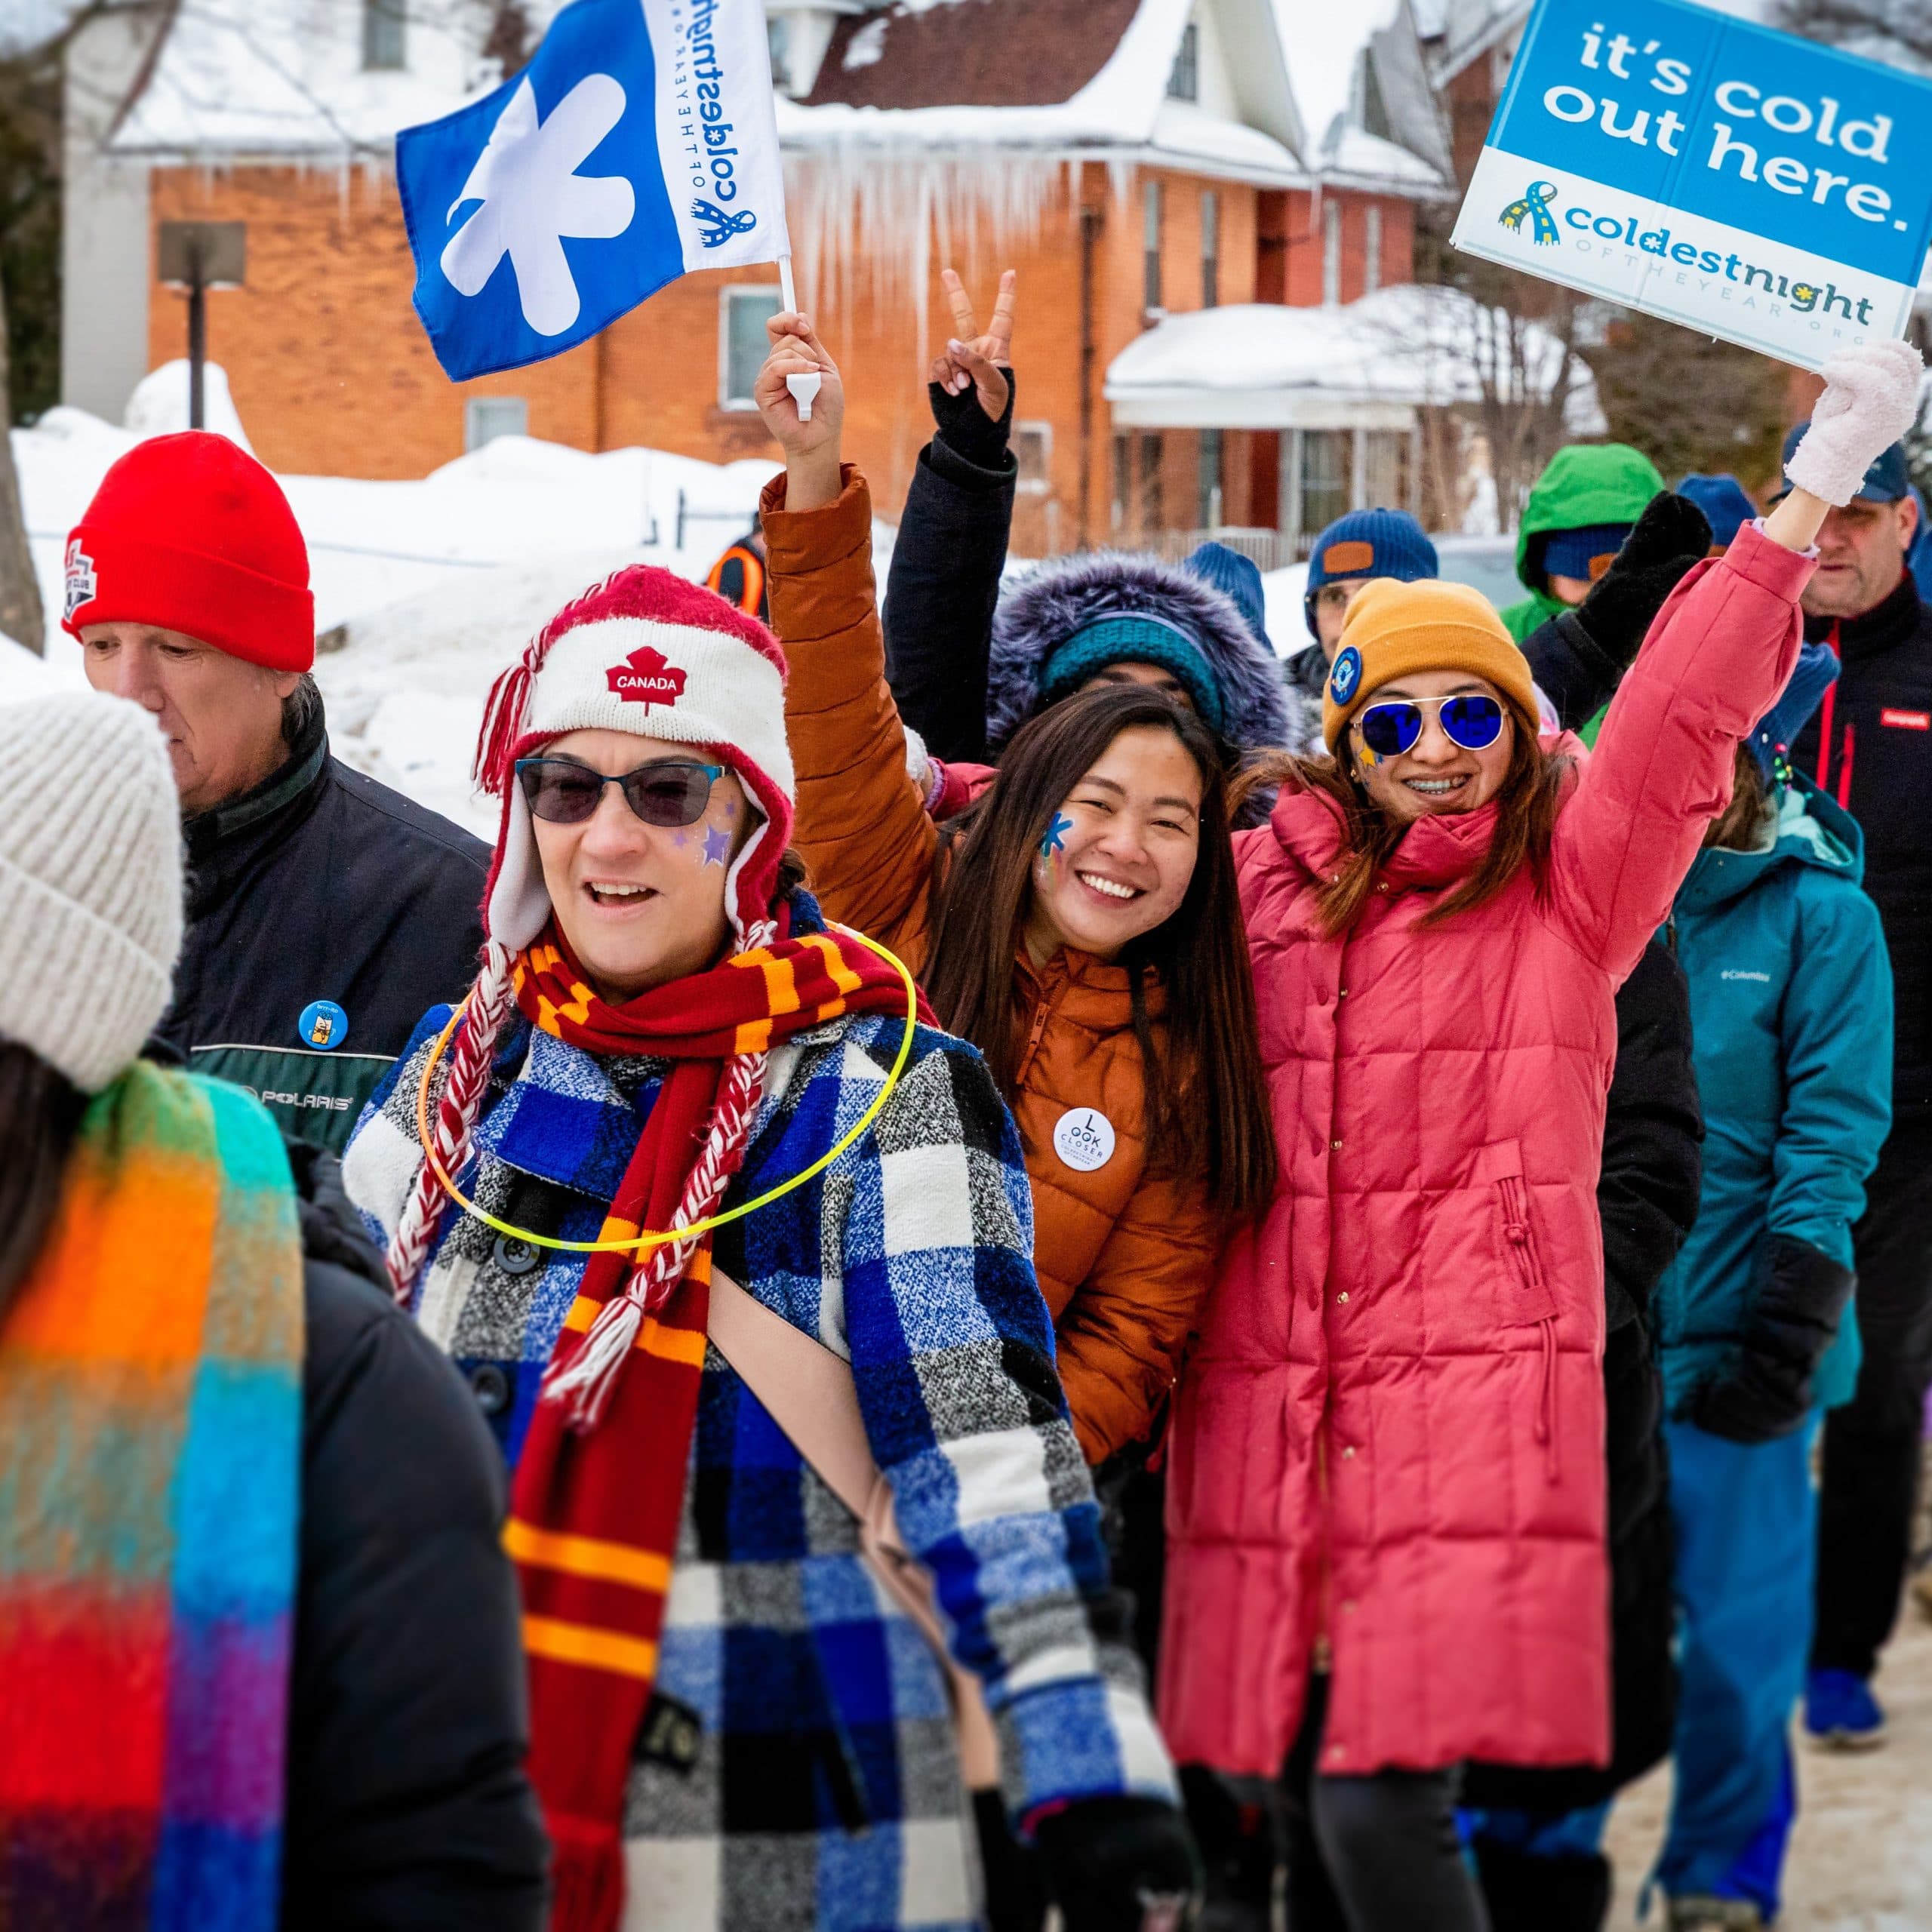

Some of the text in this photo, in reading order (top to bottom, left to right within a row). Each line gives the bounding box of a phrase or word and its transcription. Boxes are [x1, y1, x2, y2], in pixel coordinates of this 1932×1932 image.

[1580, 23, 1894, 164] it's cold
[1543, 85, 1907, 232] out here.
[1564, 207, 1874, 326] coldestnight
[617, 676, 676, 691] CANADA
[262, 1091, 349, 1111] POLARIS
[1061, 1134, 1103, 1158] CLOSER
[1071, 1127, 1101, 1147] OOK
